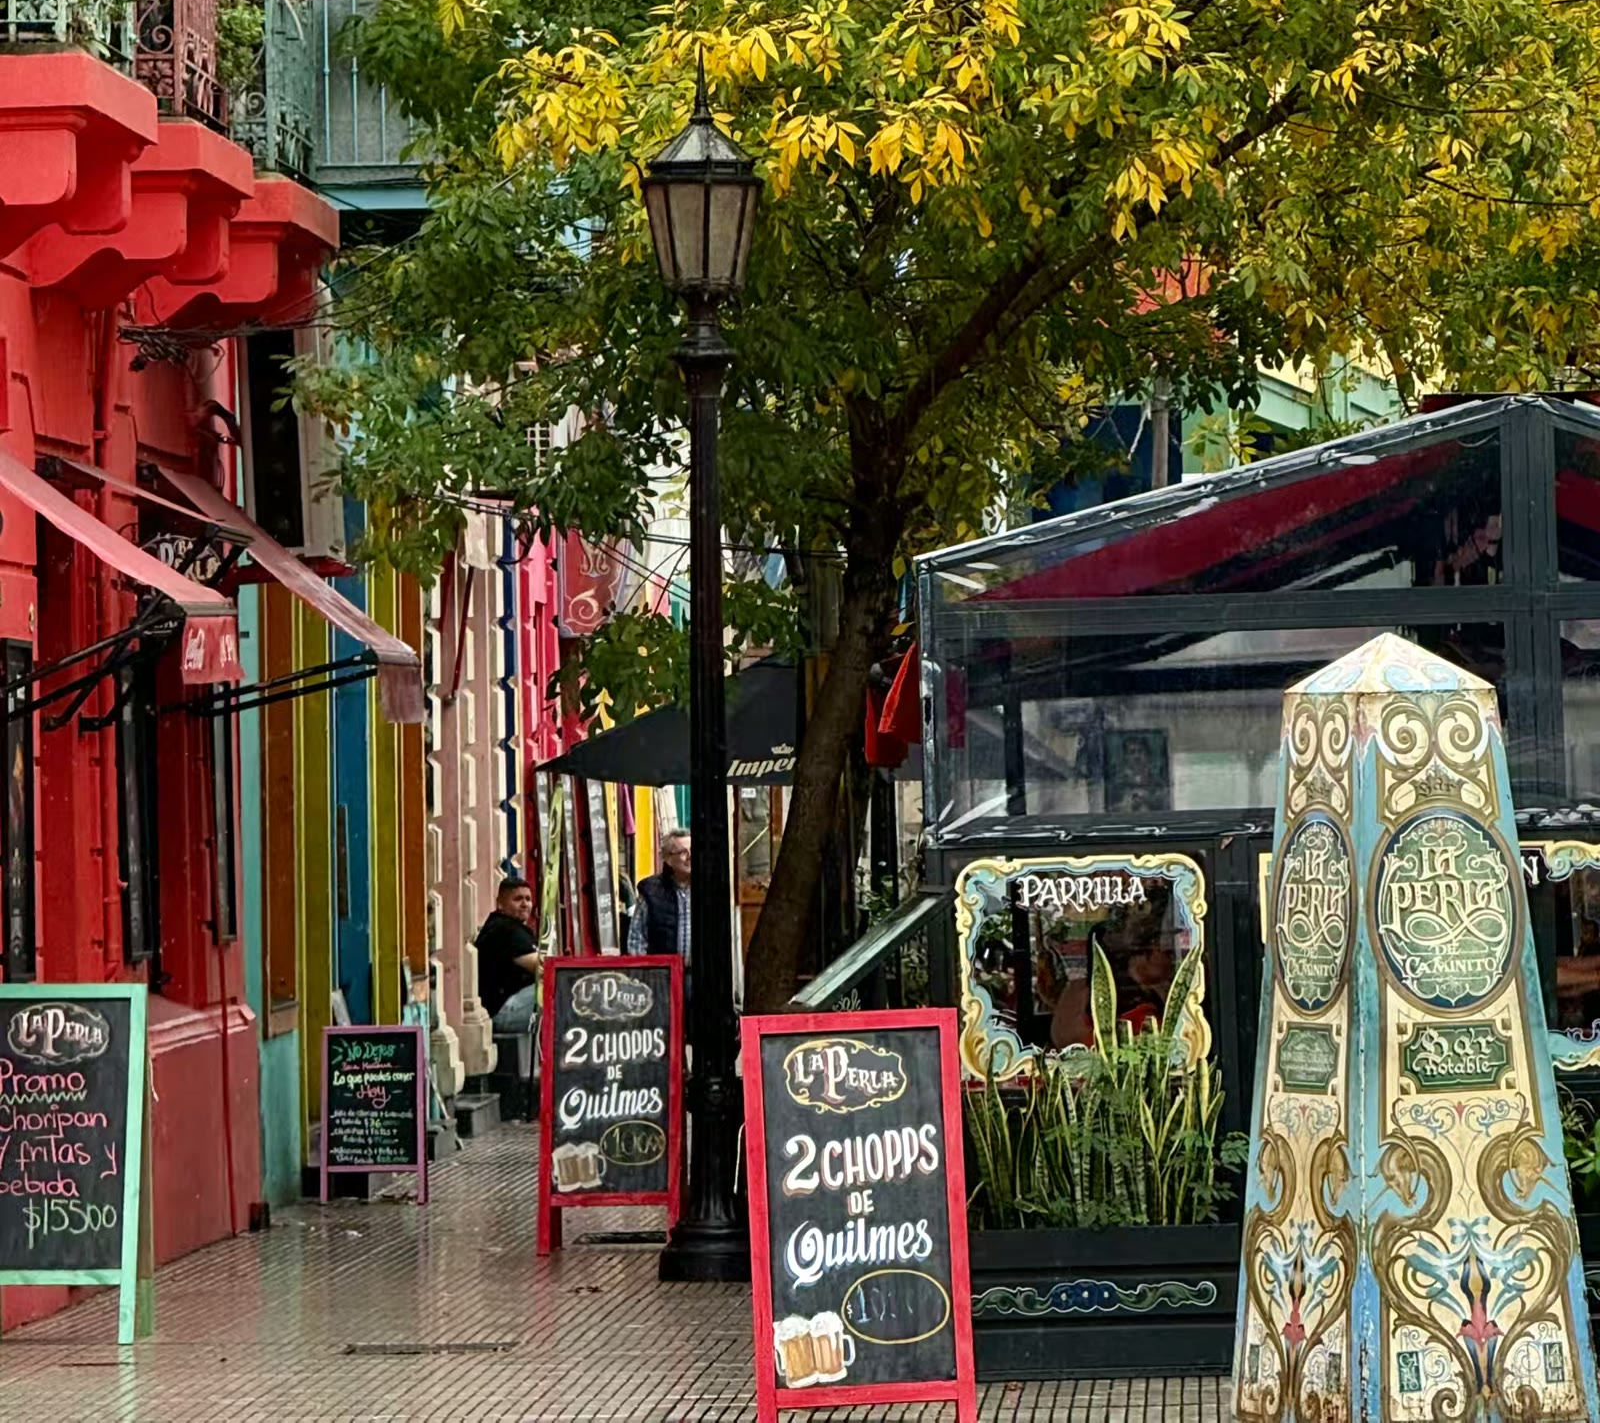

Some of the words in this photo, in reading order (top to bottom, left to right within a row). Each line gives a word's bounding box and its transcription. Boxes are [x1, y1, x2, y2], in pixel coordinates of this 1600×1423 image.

[1418, 845, 1468, 880] LA
[1016, 875, 1149, 912] PARRILLA
[1380, 878, 1508, 943] PERLA
[1277, 882, 1349, 945] PERLA
[1405, 955, 1497, 978] CAMINITO
[1433, 943, 1461, 956] DE
[564, 1027, 588, 1064] 2
[592, 1028, 666, 1064] CHOPPS
[0, 1058, 86, 1095] Promo
[606, 1064, 623, 1081] DE
[795, 1051, 824, 1085] LA
[824, 1046, 898, 1103] PERLA
[0, 1105, 108, 1137] Choripan
[559, 1082, 664, 1131] Quilmes
[100, 1141, 118, 1178] y
[784, 1133, 821, 1193] 2
[823, 1124, 940, 1191] CHOPPS
[849, 1189, 876, 1215] DE
[23, 1197, 118, 1251] $15500
[785, 1217, 934, 1291] Quilmes
